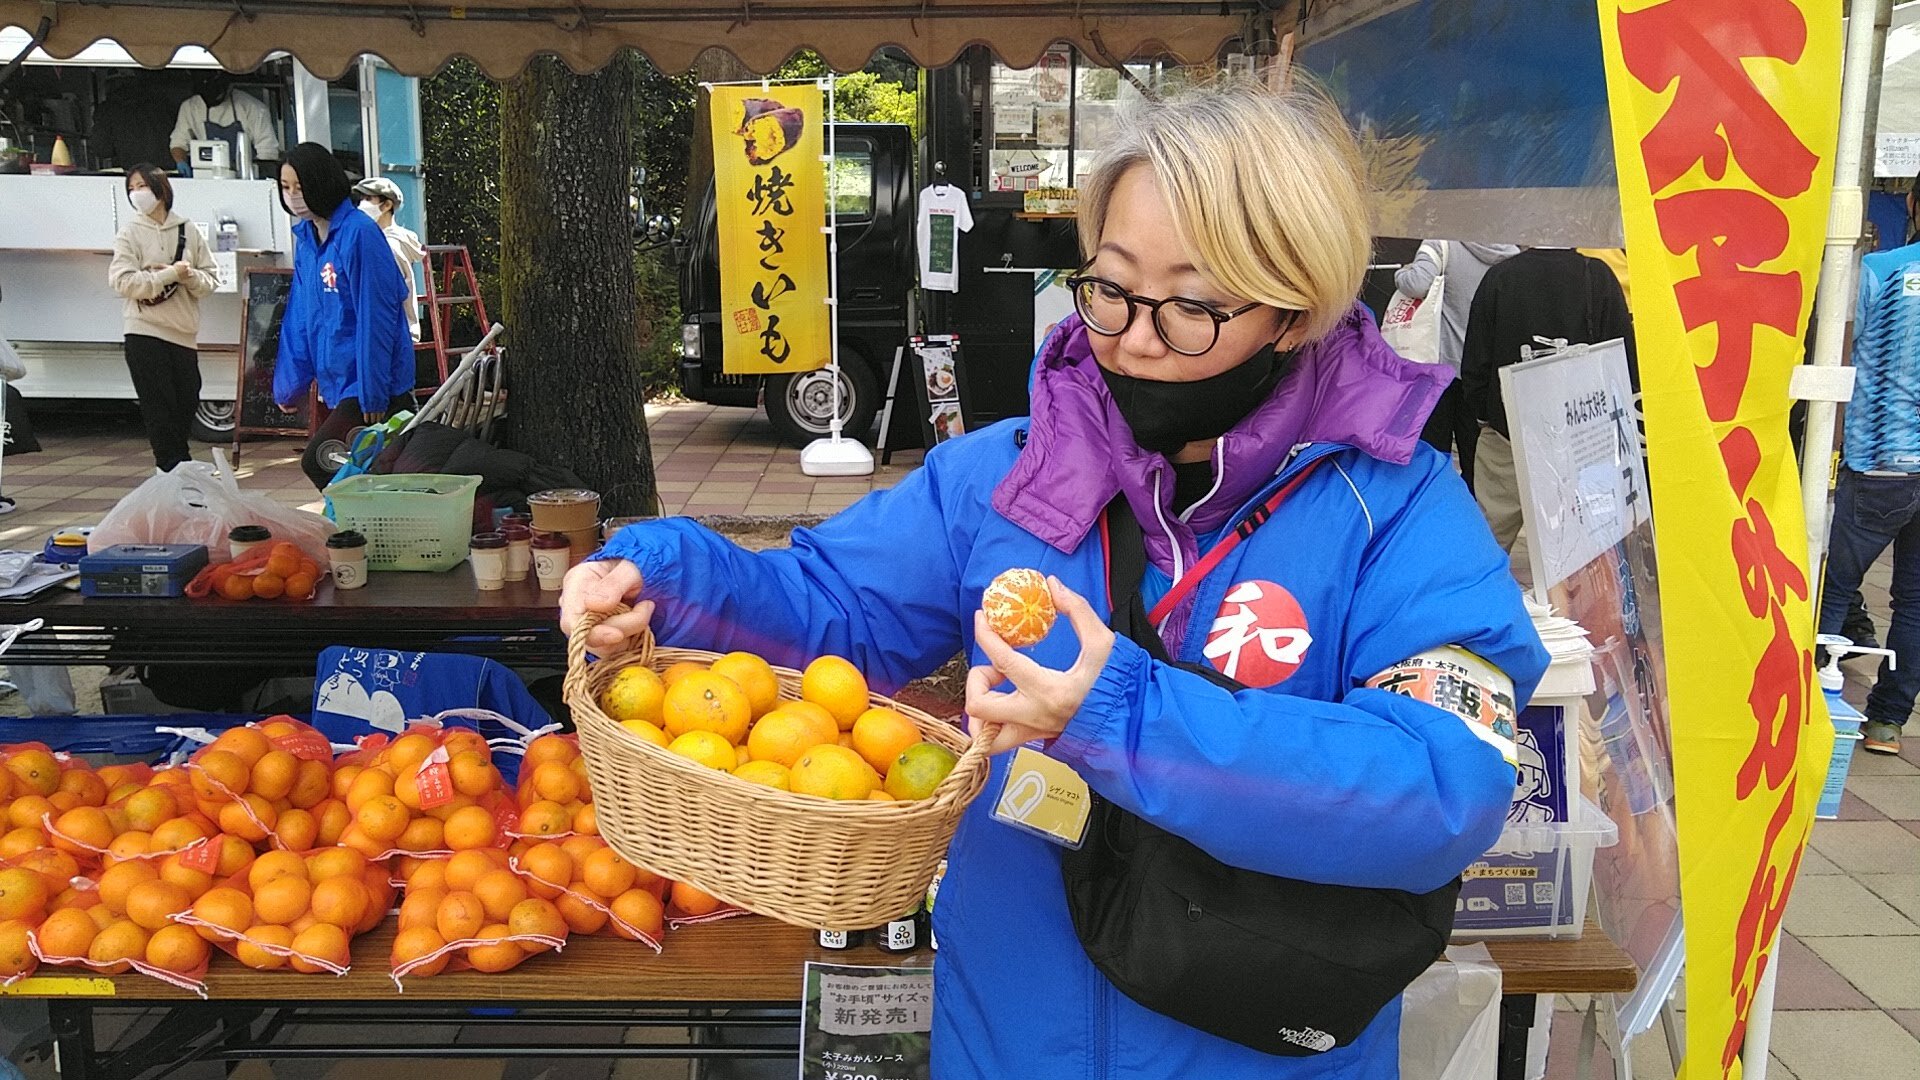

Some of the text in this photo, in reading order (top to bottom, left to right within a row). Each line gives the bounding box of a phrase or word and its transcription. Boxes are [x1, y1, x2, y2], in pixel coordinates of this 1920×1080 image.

[1010, 163, 1040, 173] WELCOME
[1039, 189, 1079, 200] ALOHA
[746, 165, 797, 364] 焼きいも
[1564, 389, 1609, 427] みんな大好き
[1203, 581, 1313, 680] 和
[1278, 1027, 1316, 1043] NORTH
[1302, 1026, 1326, 1039] THE
[822, 1051, 904, 1063] 太子みかんソース
